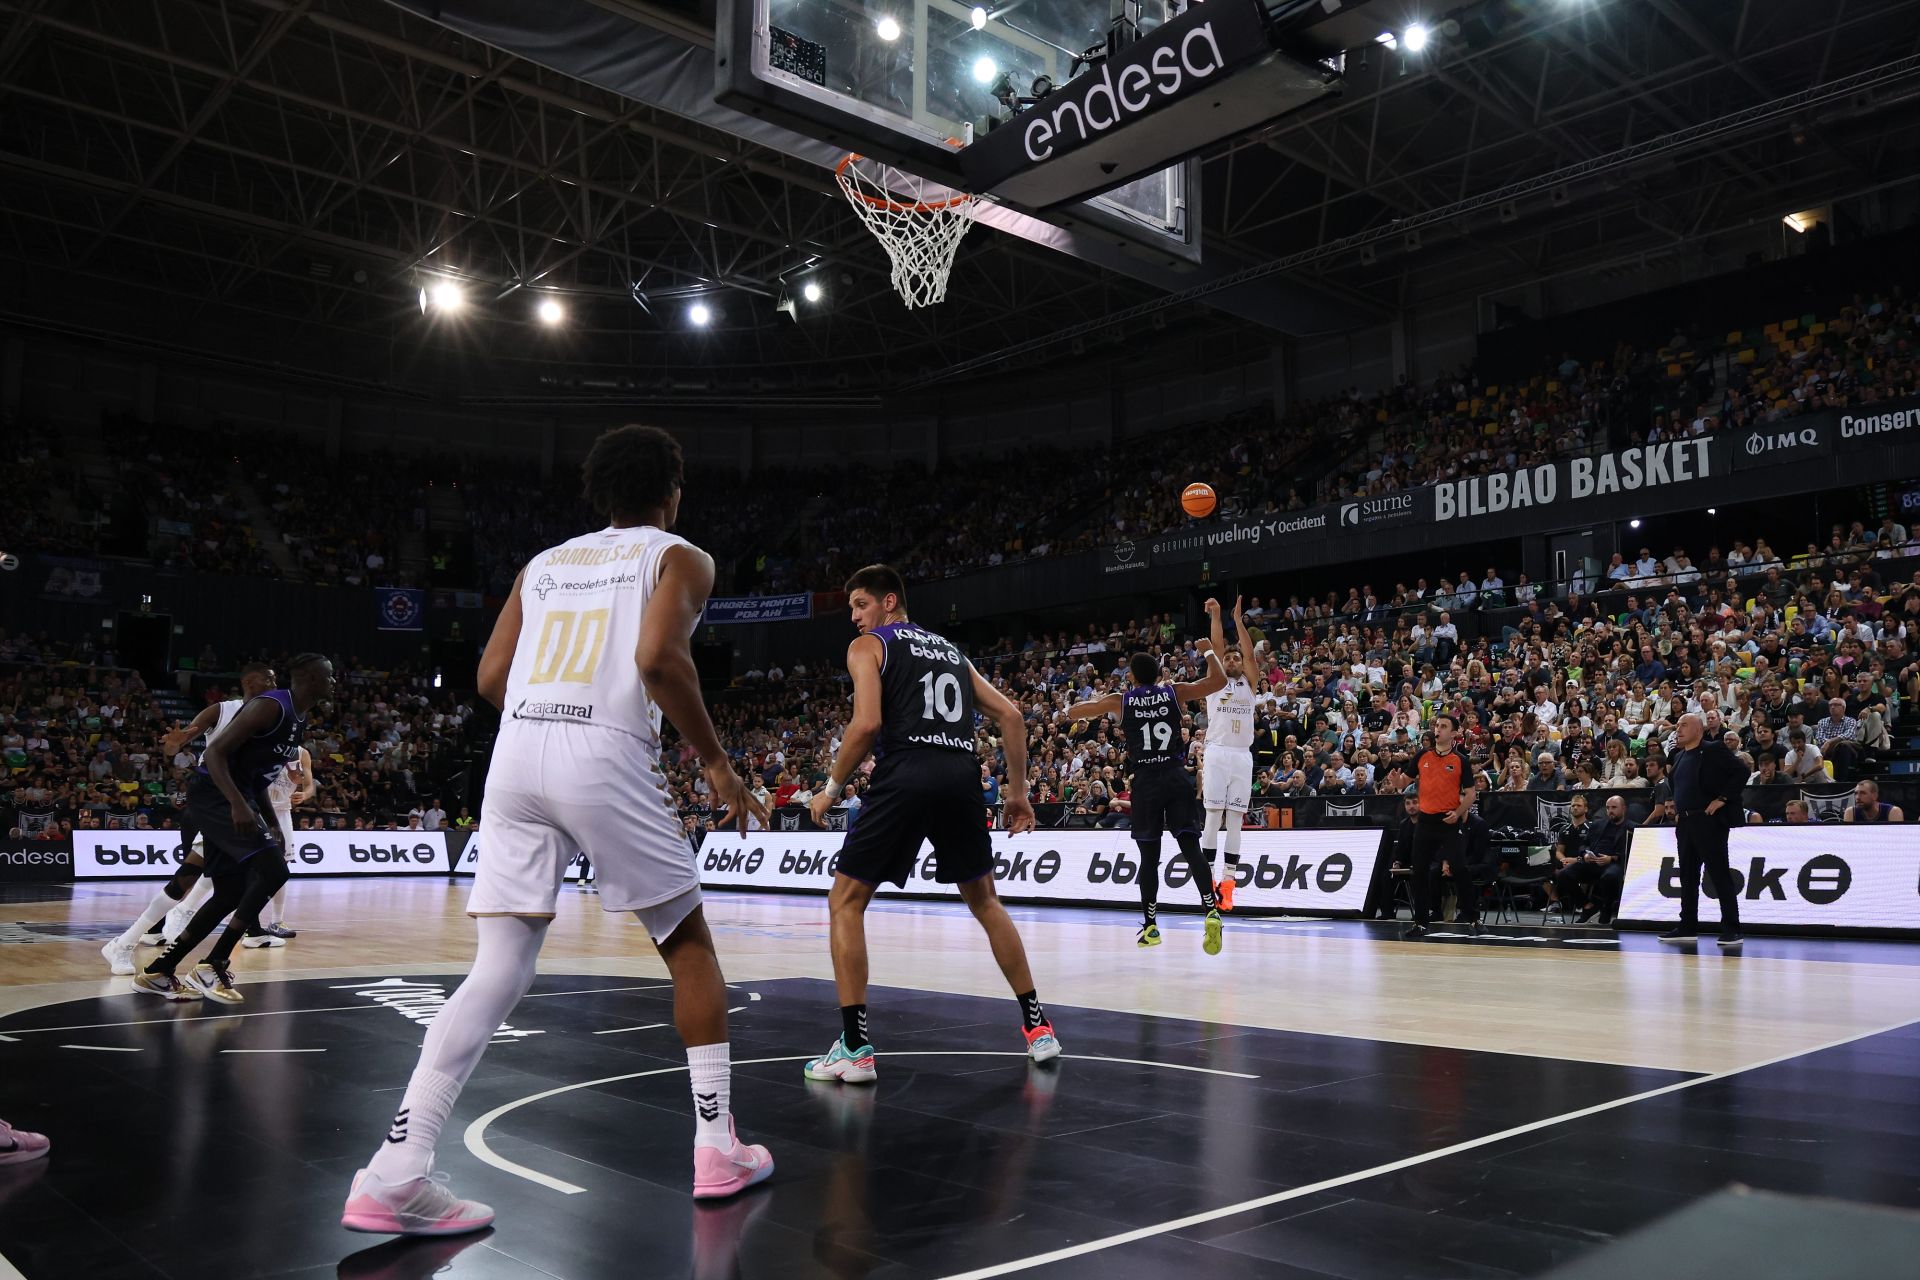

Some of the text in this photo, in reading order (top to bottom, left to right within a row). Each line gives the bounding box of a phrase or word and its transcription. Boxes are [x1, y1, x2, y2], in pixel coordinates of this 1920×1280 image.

[1024, 21, 1225, 162] endesa
[1766, 428, 1819, 450] IMQ
[1435, 436, 1714, 521] BILBAO BASKET
[1363, 494, 1412, 515] surne
[1207, 521, 1262, 546] vueling
[1278, 514, 1326, 534] Occident
[545, 543, 646, 567] SAMUELS JR
[1162, 536, 1204, 553] SERINFOR
[611, 573, 636, 584] salud
[760, 596, 805, 609] MONTES
[734, 610, 760, 619] POR
[527, 607, 610, 685] 00
[893, 628, 959, 653] KRAMPE
[910, 643, 949, 661] bbk
[918, 670, 963, 723] 10
[1128, 691, 1171, 707] PANTZAR
[526, 699, 594, 719] cajarural
[1134, 708, 1159, 719] bbk
[1139, 721, 1173, 751] 19
[1231, 719, 1241, 734] 19
[94, 844, 170, 866] bbk
[349, 843, 411, 863] bbk
[703, 847, 747, 875] bbk
[779, 849, 829, 876] bbk
[992, 851, 1032, 881] bk
[1087, 852, 1161, 884] bb
